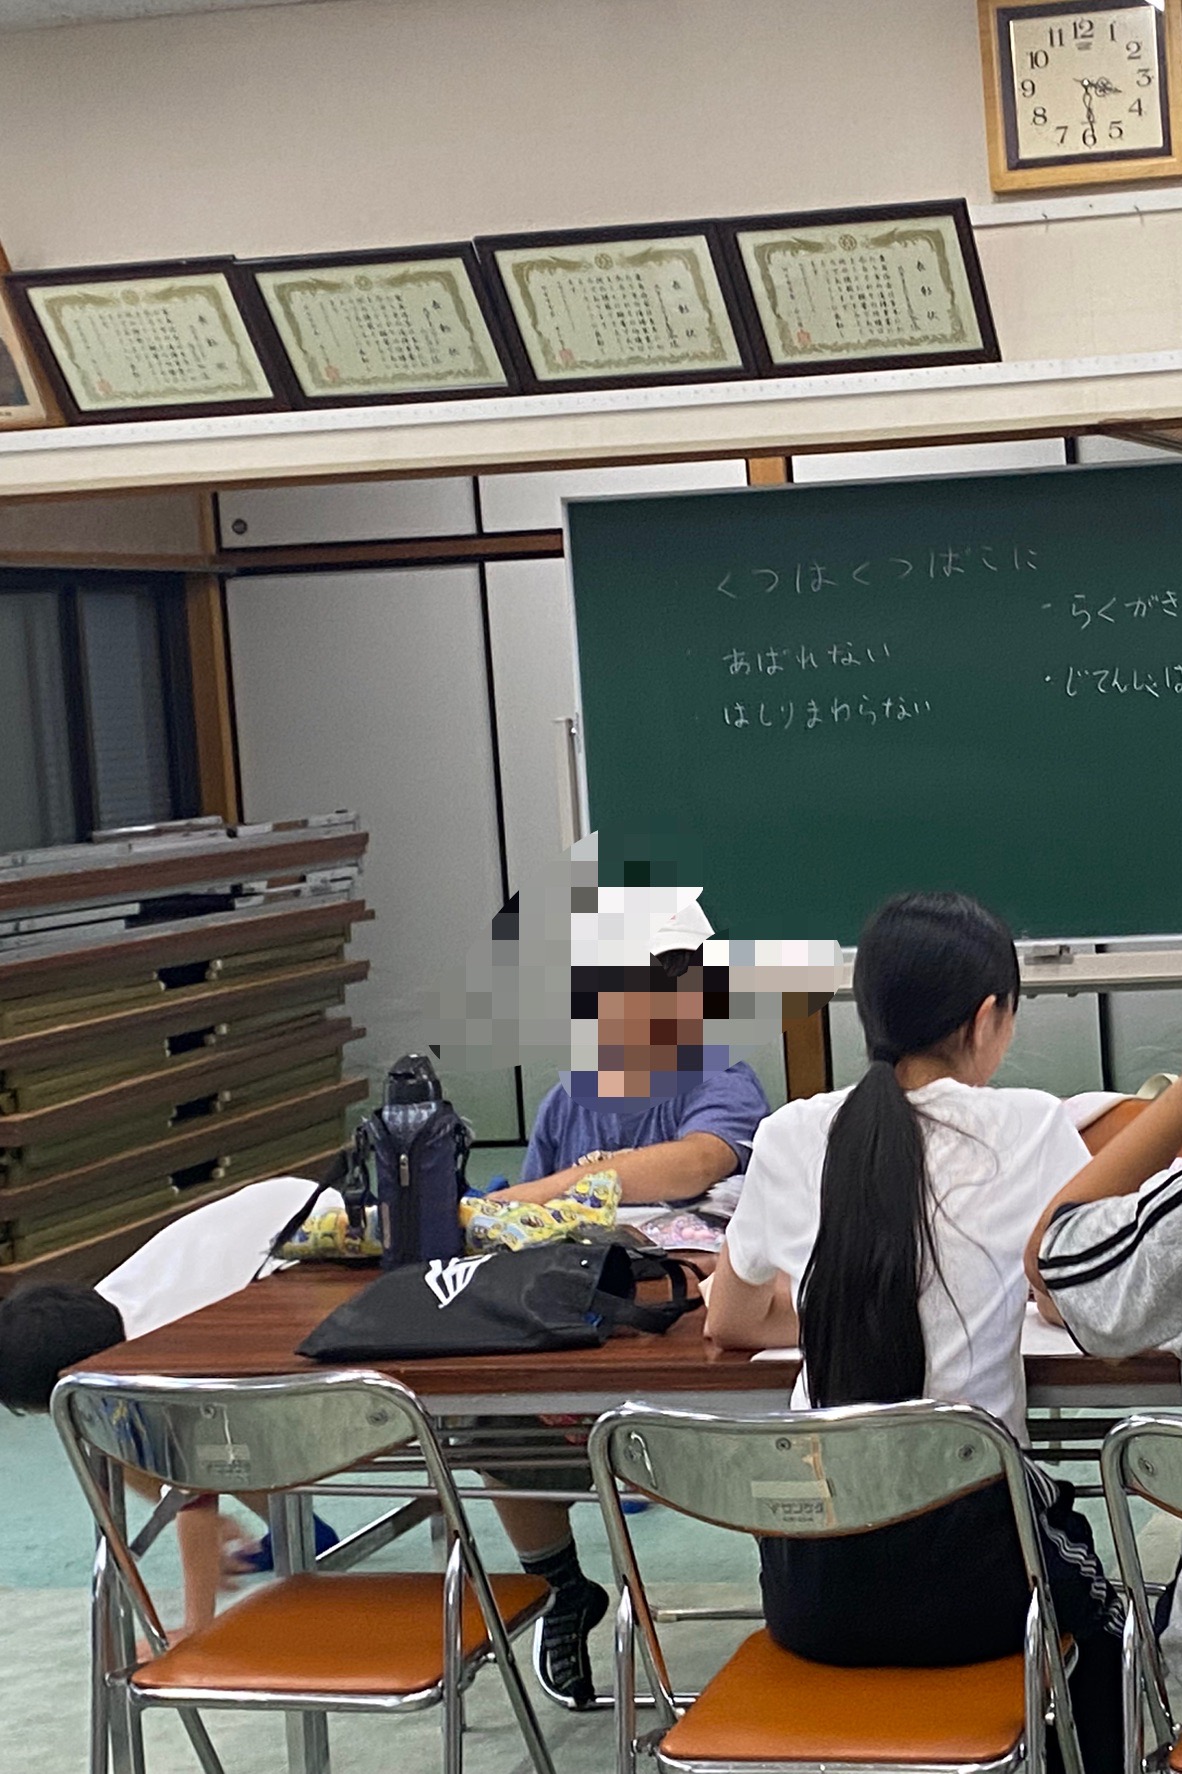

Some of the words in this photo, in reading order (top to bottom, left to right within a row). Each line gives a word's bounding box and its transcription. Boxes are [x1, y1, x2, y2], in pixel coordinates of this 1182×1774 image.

[1049, 27, 1064, 47] 11
[1073, 19, 1094, 40] 12
[1109, 22, 1117, 42] 1
[1028, 50, 1049, 69] 10
[1125, 41, 1142, 60] 2
[1136, 69, 1152, 87] 3
[1020, 79, 1036, 98] 9
[1032, 107, 1047, 126] 8
[1128, 98, 1143, 117] 4
[1055, 126, 1069, 145] 7
[1082, 129, 1097, 148] 6
[1108, 121, 1123, 140] 5
[717, 546, 1038, 599] くつはくつばこに
[722, 642, 890, 675] あばれない
[723, 694, 931, 729] はしりまわらない
